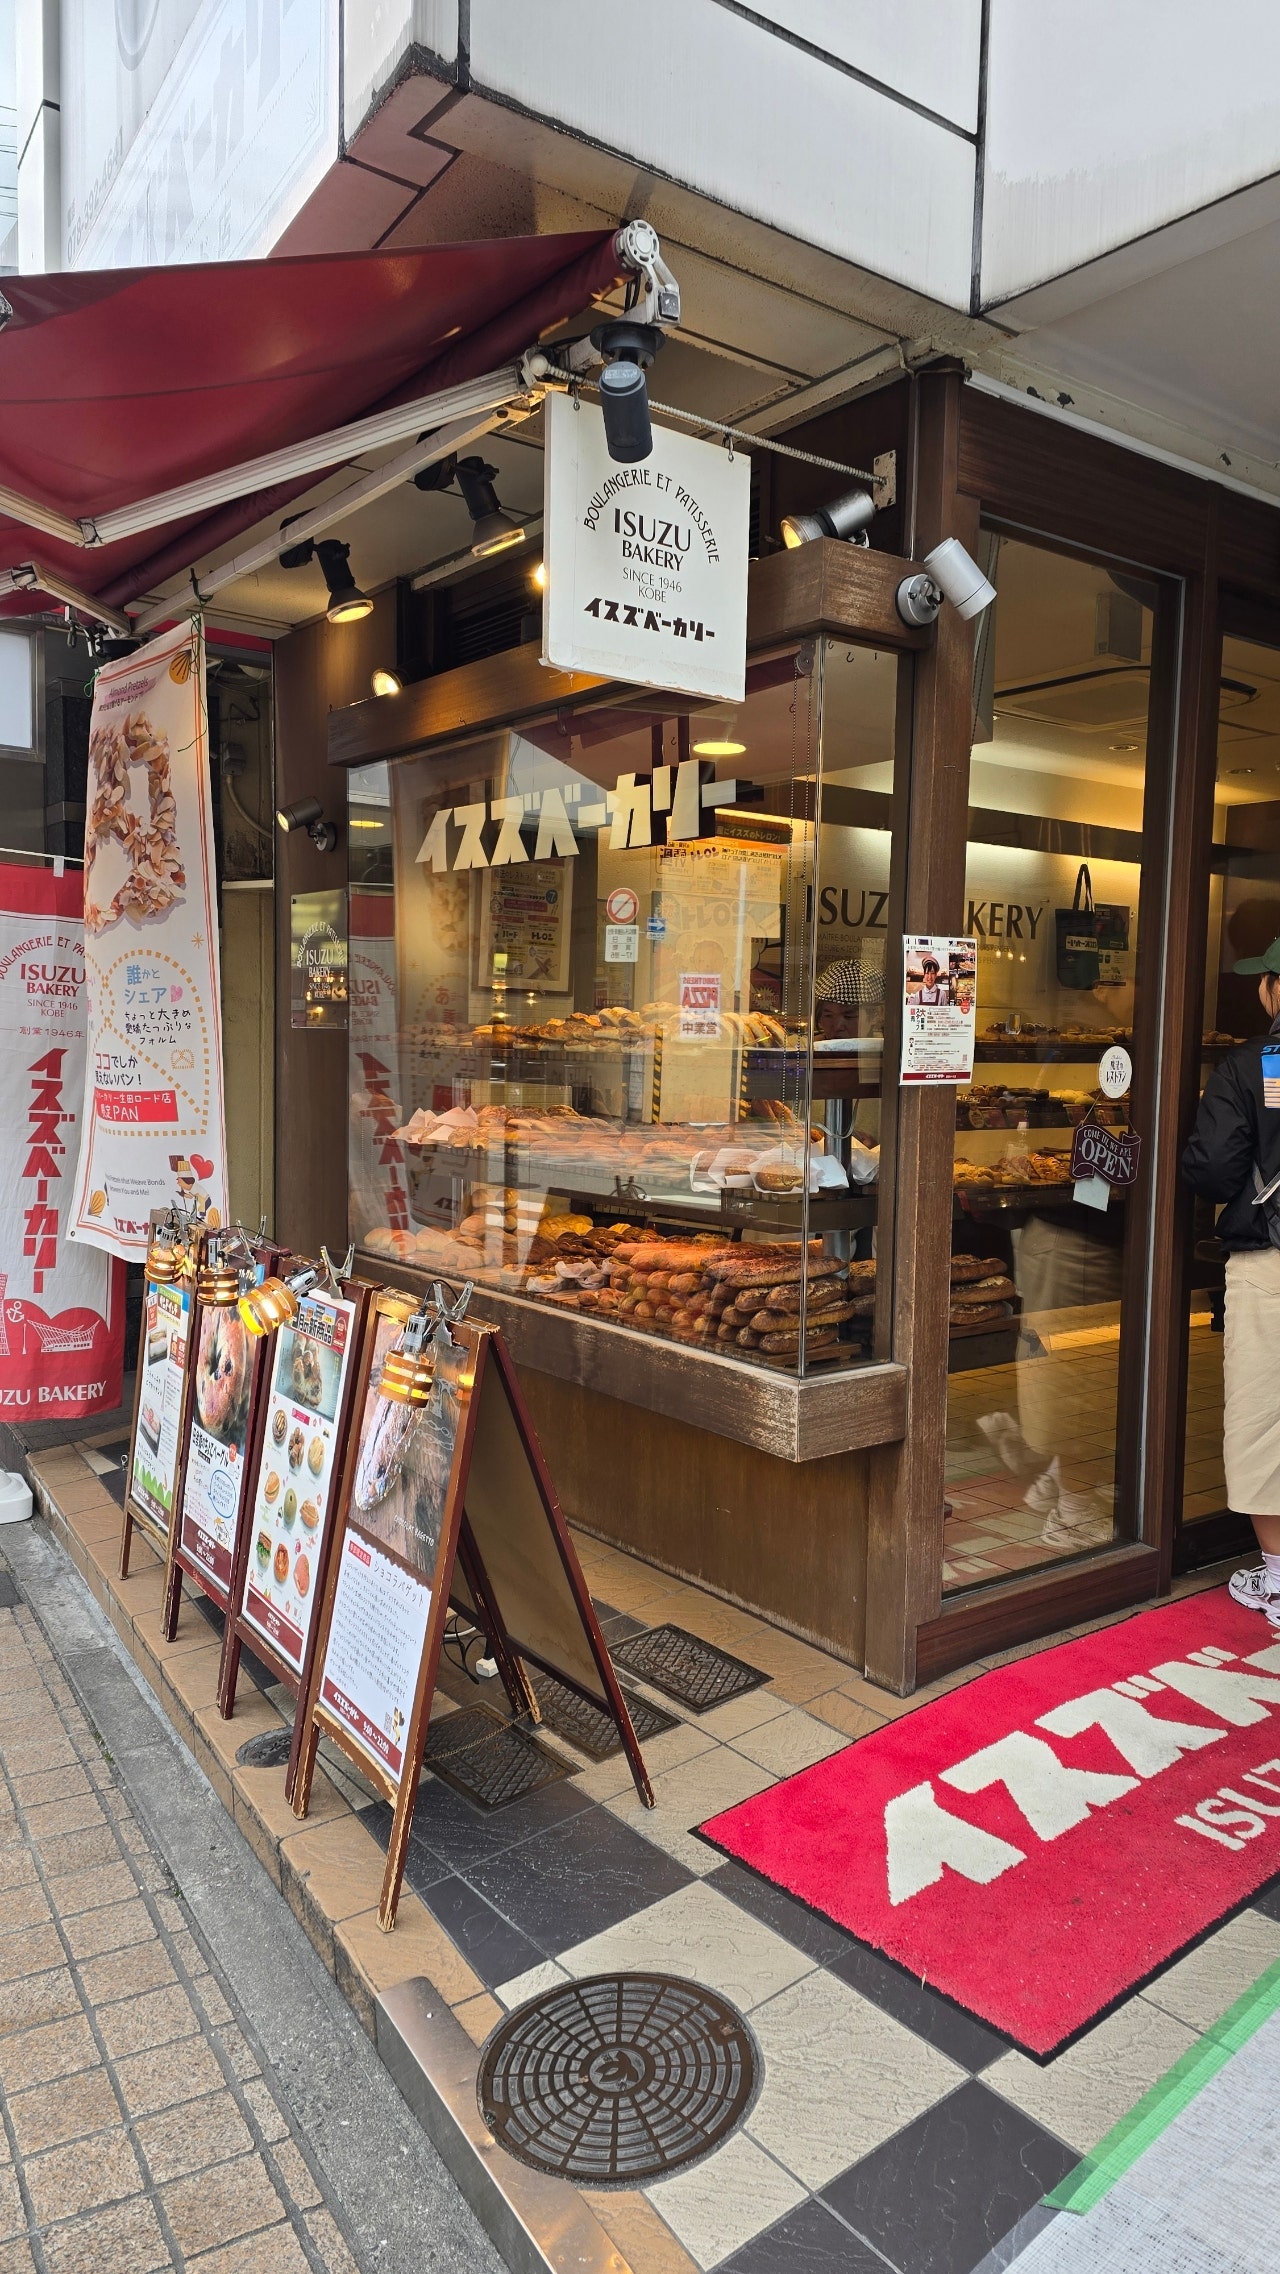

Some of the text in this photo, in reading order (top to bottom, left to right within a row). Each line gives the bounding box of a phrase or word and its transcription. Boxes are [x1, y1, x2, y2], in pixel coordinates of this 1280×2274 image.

[583, 468, 720, 564] BOULANGERIE ET PATISSERIE
[613, 507, 691, 552] ISUZU
[622, 539, 684, 572] BAKERY
[622, 566, 682, 593] SINCE 1946
[637, 585, 667, 603] KOBE
[583, 597, 715, 642] イスズベーカリー
[415, 759, 737, 873] イスズベーカリー
[806, 884, 1043, 940] ISUZ KERY
[57, 936, 71, 949] ET
[306, 948, 334, 966] ISUZU
[20, 963, 87, 985] ISUZU
[126, 964, 161, 986] 誰かと
[308, 966, 330, 978] BAKERY
[26, 982, 80, 998] BAKERY
[124, 987, 167, 1005] シェア
[27, 999, 78, 1011] SINCE 1946
[40, 1008, 65, 1018] KOBE
[124, 1009, 191, 1022] ちょっと大きめ
[20, 1025, 85, 1038] 創業1946年
[139, 1035, 177, 1045] フォルム
[1260, 1044, 1280, 1054] ST
[95, 1053, 138, 1070] ココでしか
[1083, 1129, 1101, 1143] COME
[1081, 1138, 1133, 1179] OPEN
[22, 1048, 75, 1293] イスズベーカリー
[147, 1178, 166, 1186] Bonds
[291, 1314, 332, 1344] 月の新商品
[0, 1380, 107, 1406] ZU BAKERY
